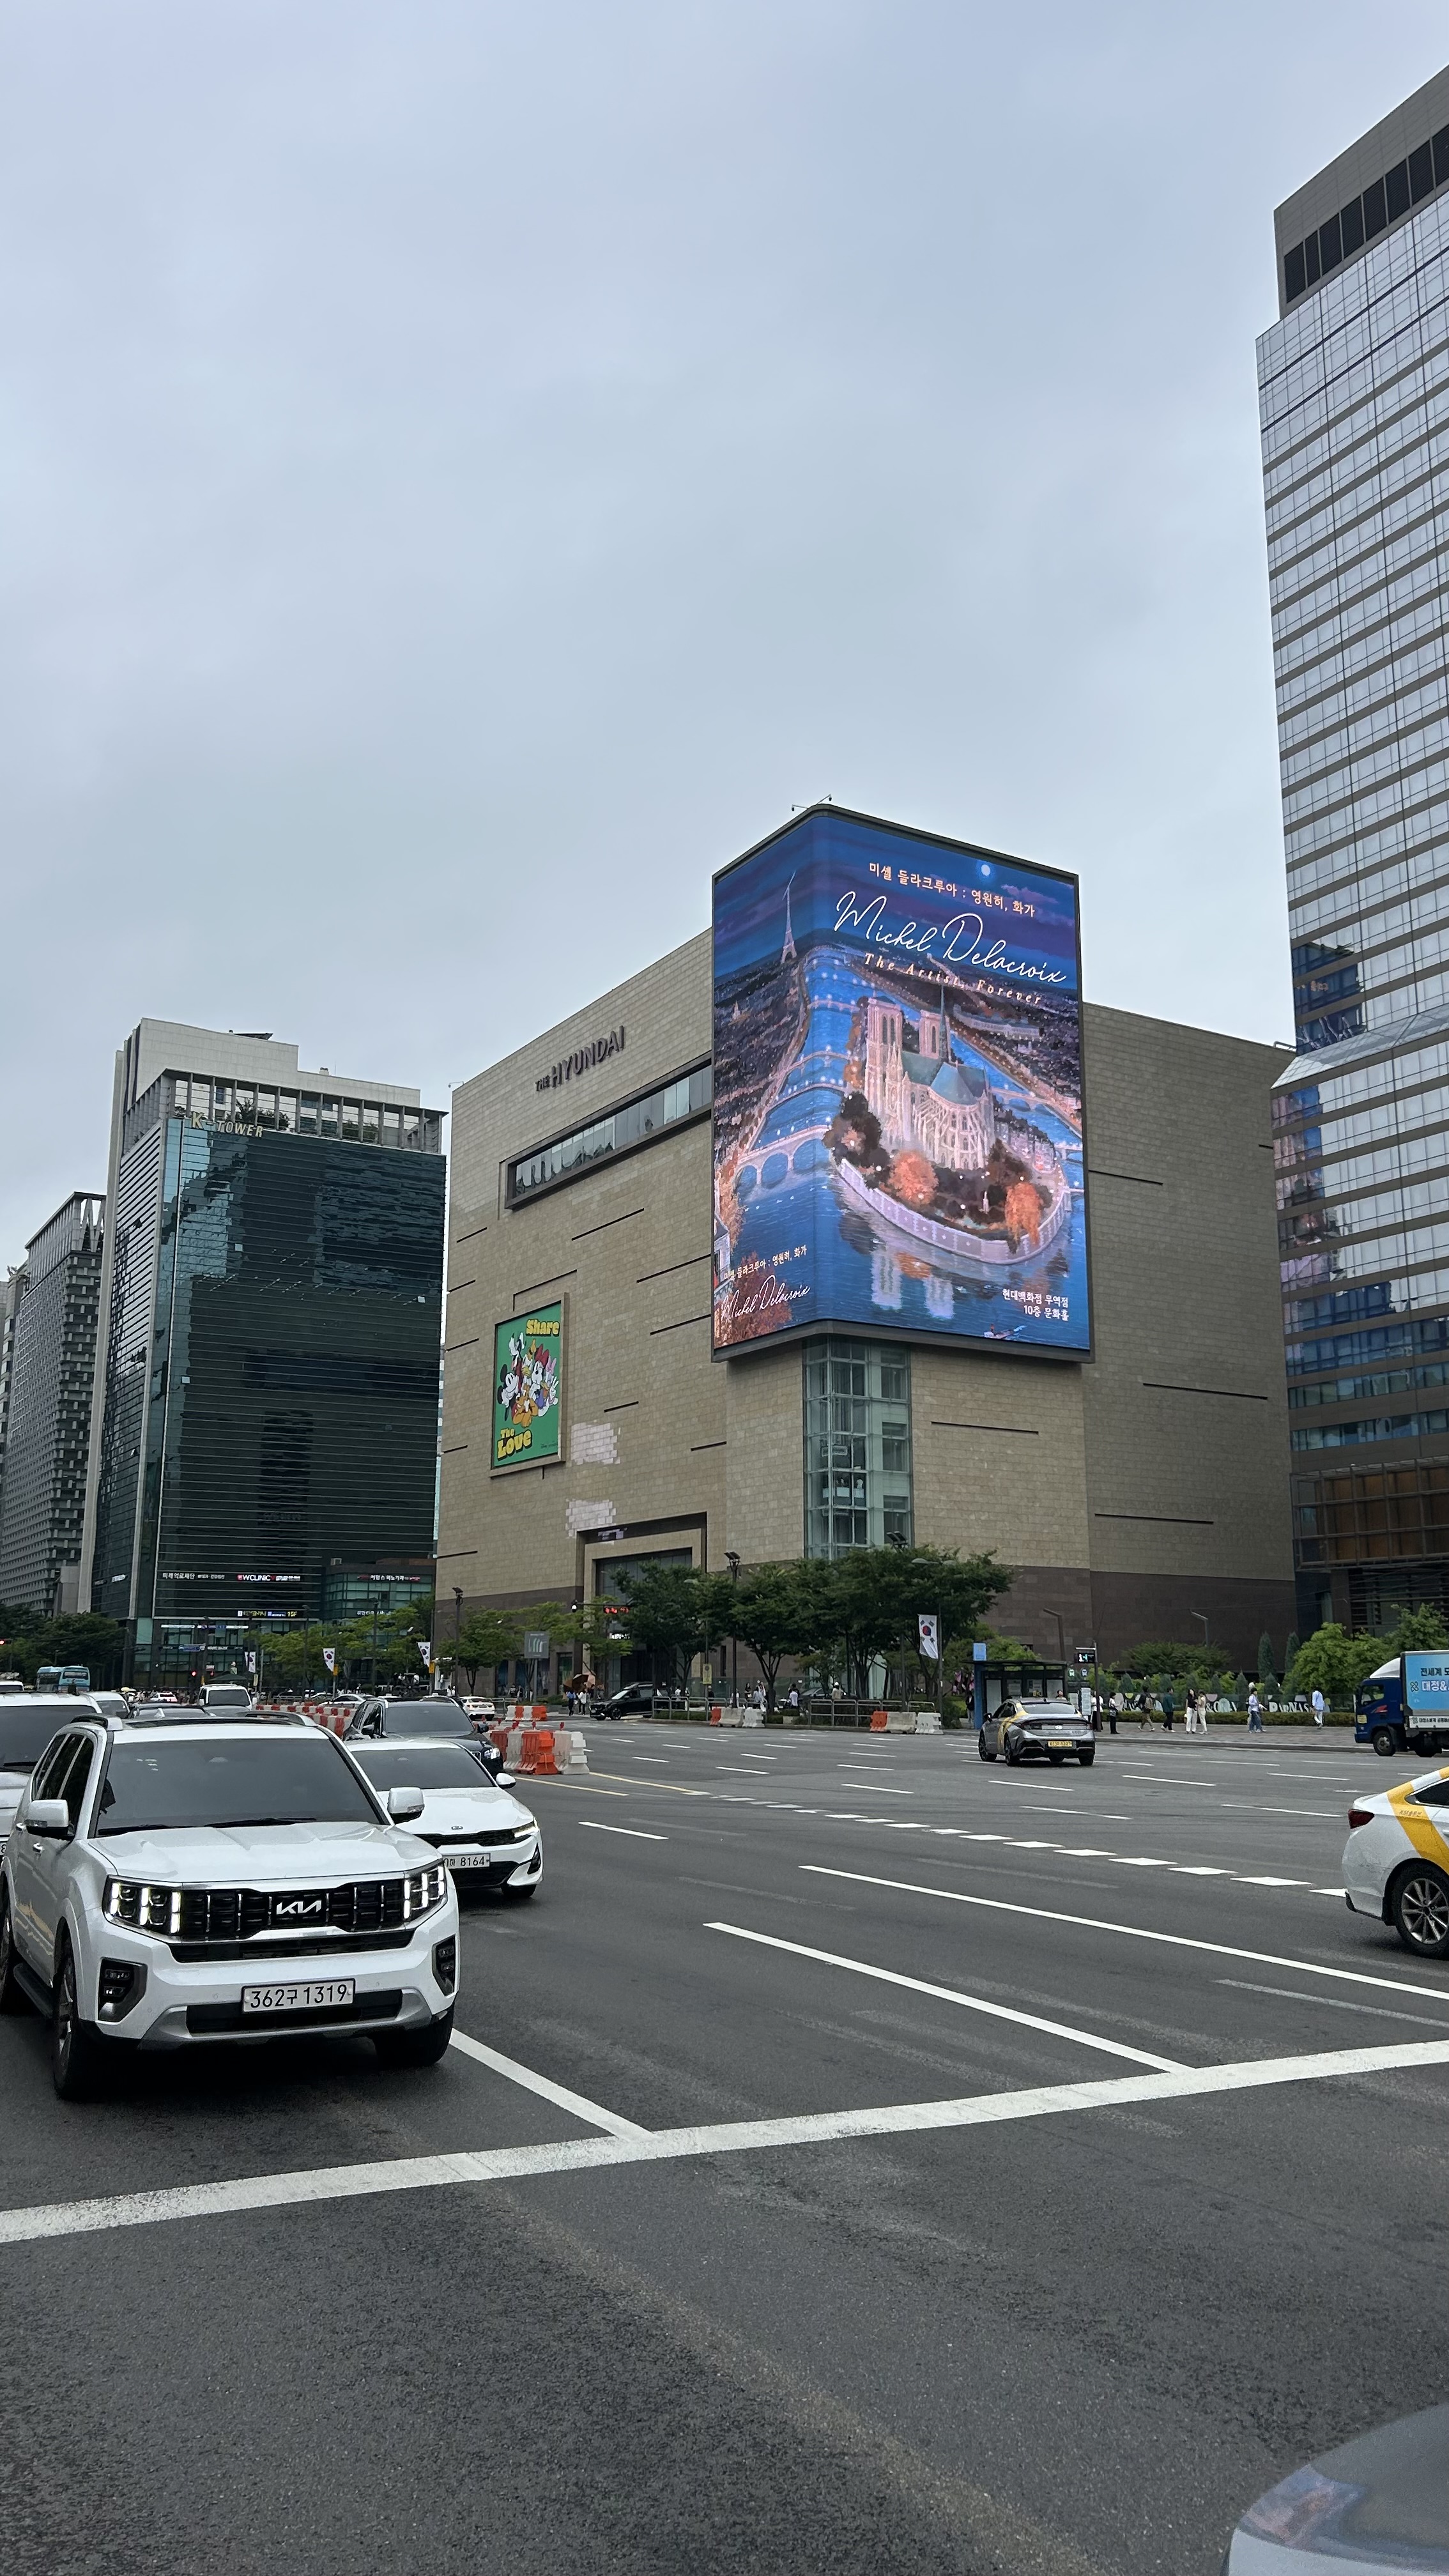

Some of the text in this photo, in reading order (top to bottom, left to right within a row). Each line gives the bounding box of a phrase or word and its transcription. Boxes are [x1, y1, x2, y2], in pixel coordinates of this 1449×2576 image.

[897, 870, 957, 897] 들라크루아
[1013, 900, 1035, 917] 화가
[833, 891, 1066, 984] Michel Delacroix
[864, 953, 1041, 1005] The Artist, Forever
[535, 1025, 625, 1092] THE HYUNDAI
[721, 1275, 811, 1321] Michel Delacroix
[1002, 1288, 1069, 1308] 현대백화점 무역점
[1023, 1305, 1070, 1321] 10층 문화홀
[526, 1319, 560, 1337] Share
[500, 1428, 516, 1438] The
[460, 1855, 485, 1867] 8164
[303, 1984, 348, 2004] 1319
